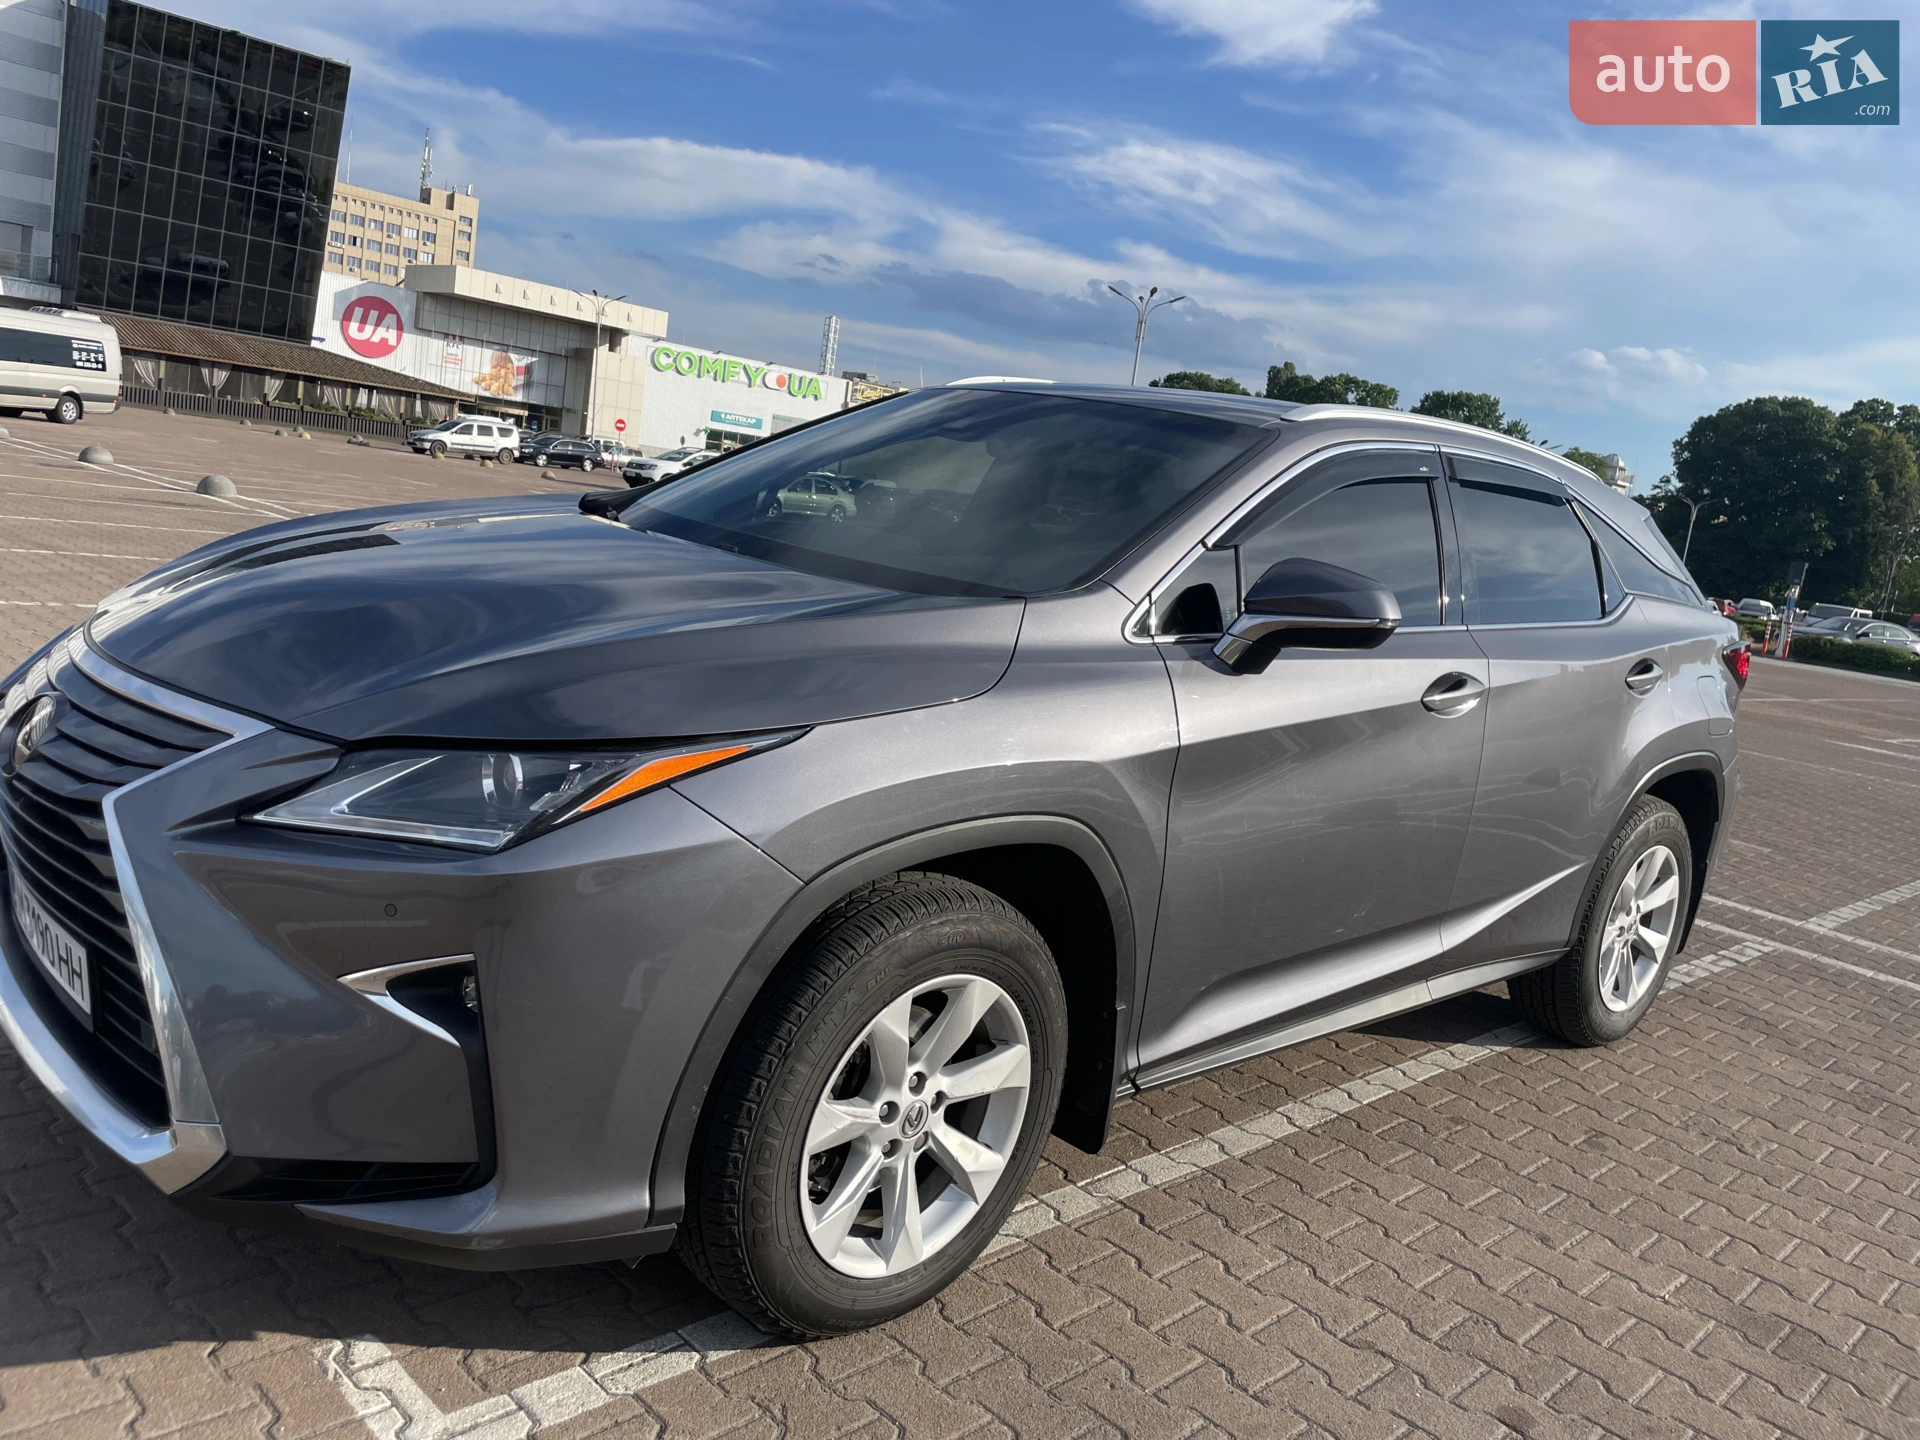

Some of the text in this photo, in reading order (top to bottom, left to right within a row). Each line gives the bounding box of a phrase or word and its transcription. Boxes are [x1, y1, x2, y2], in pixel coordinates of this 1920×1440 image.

[348, 306, 398, 346] UA
[653, 346, 823, 401] COMFY UA
[751, 1062, 805, 1247] ROADIAN
